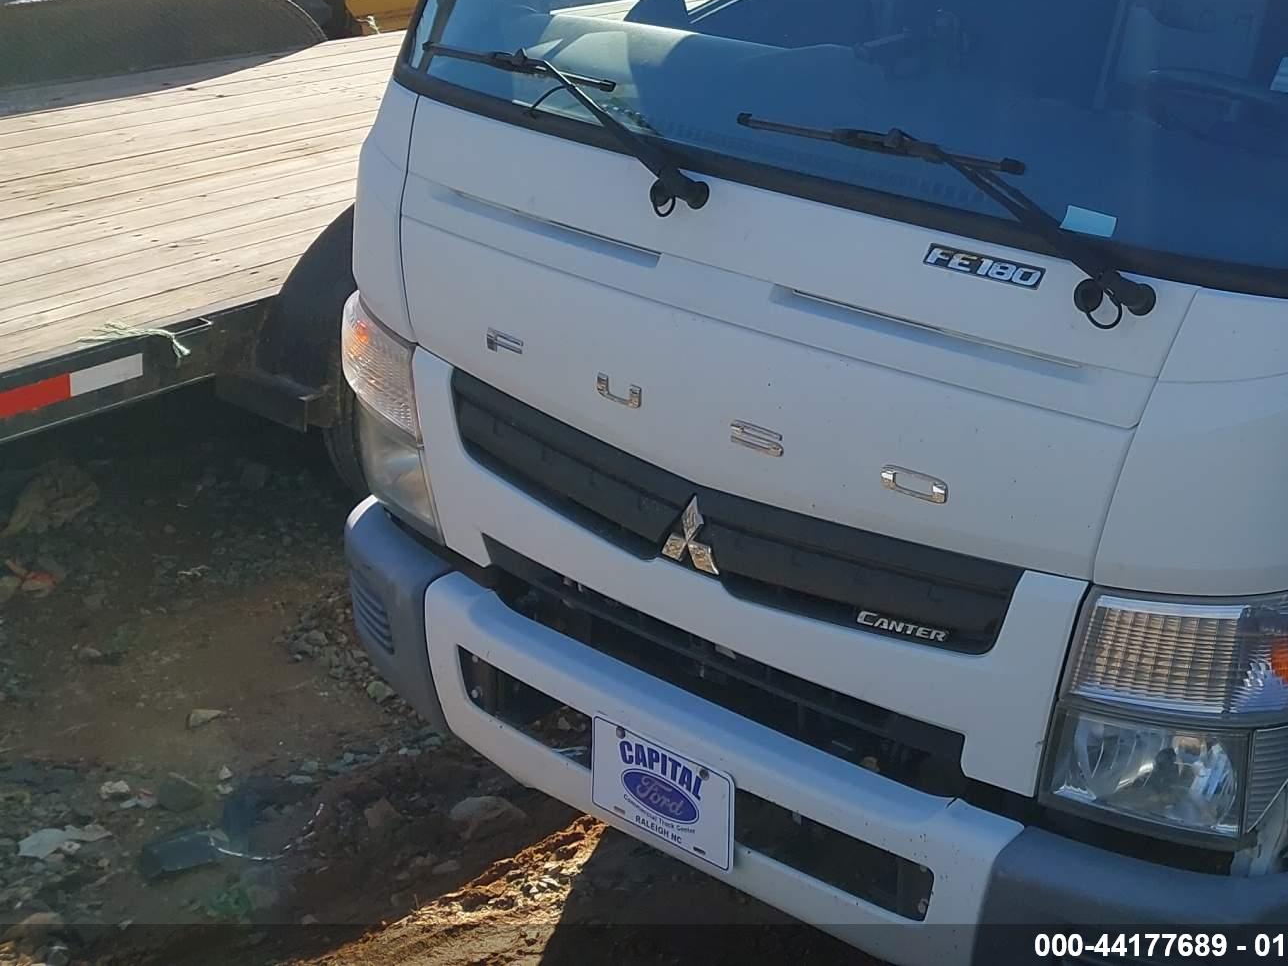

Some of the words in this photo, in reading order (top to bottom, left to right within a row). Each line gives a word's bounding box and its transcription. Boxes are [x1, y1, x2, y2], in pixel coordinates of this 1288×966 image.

[857, 610, 946, 642] CANTER
[619, 740, 702, 801] CAPITAL
[637, 775, 685, 816] Ford
[635, 815, 669, 838] RALEIGH
[671, 833, 683, 845] NC
